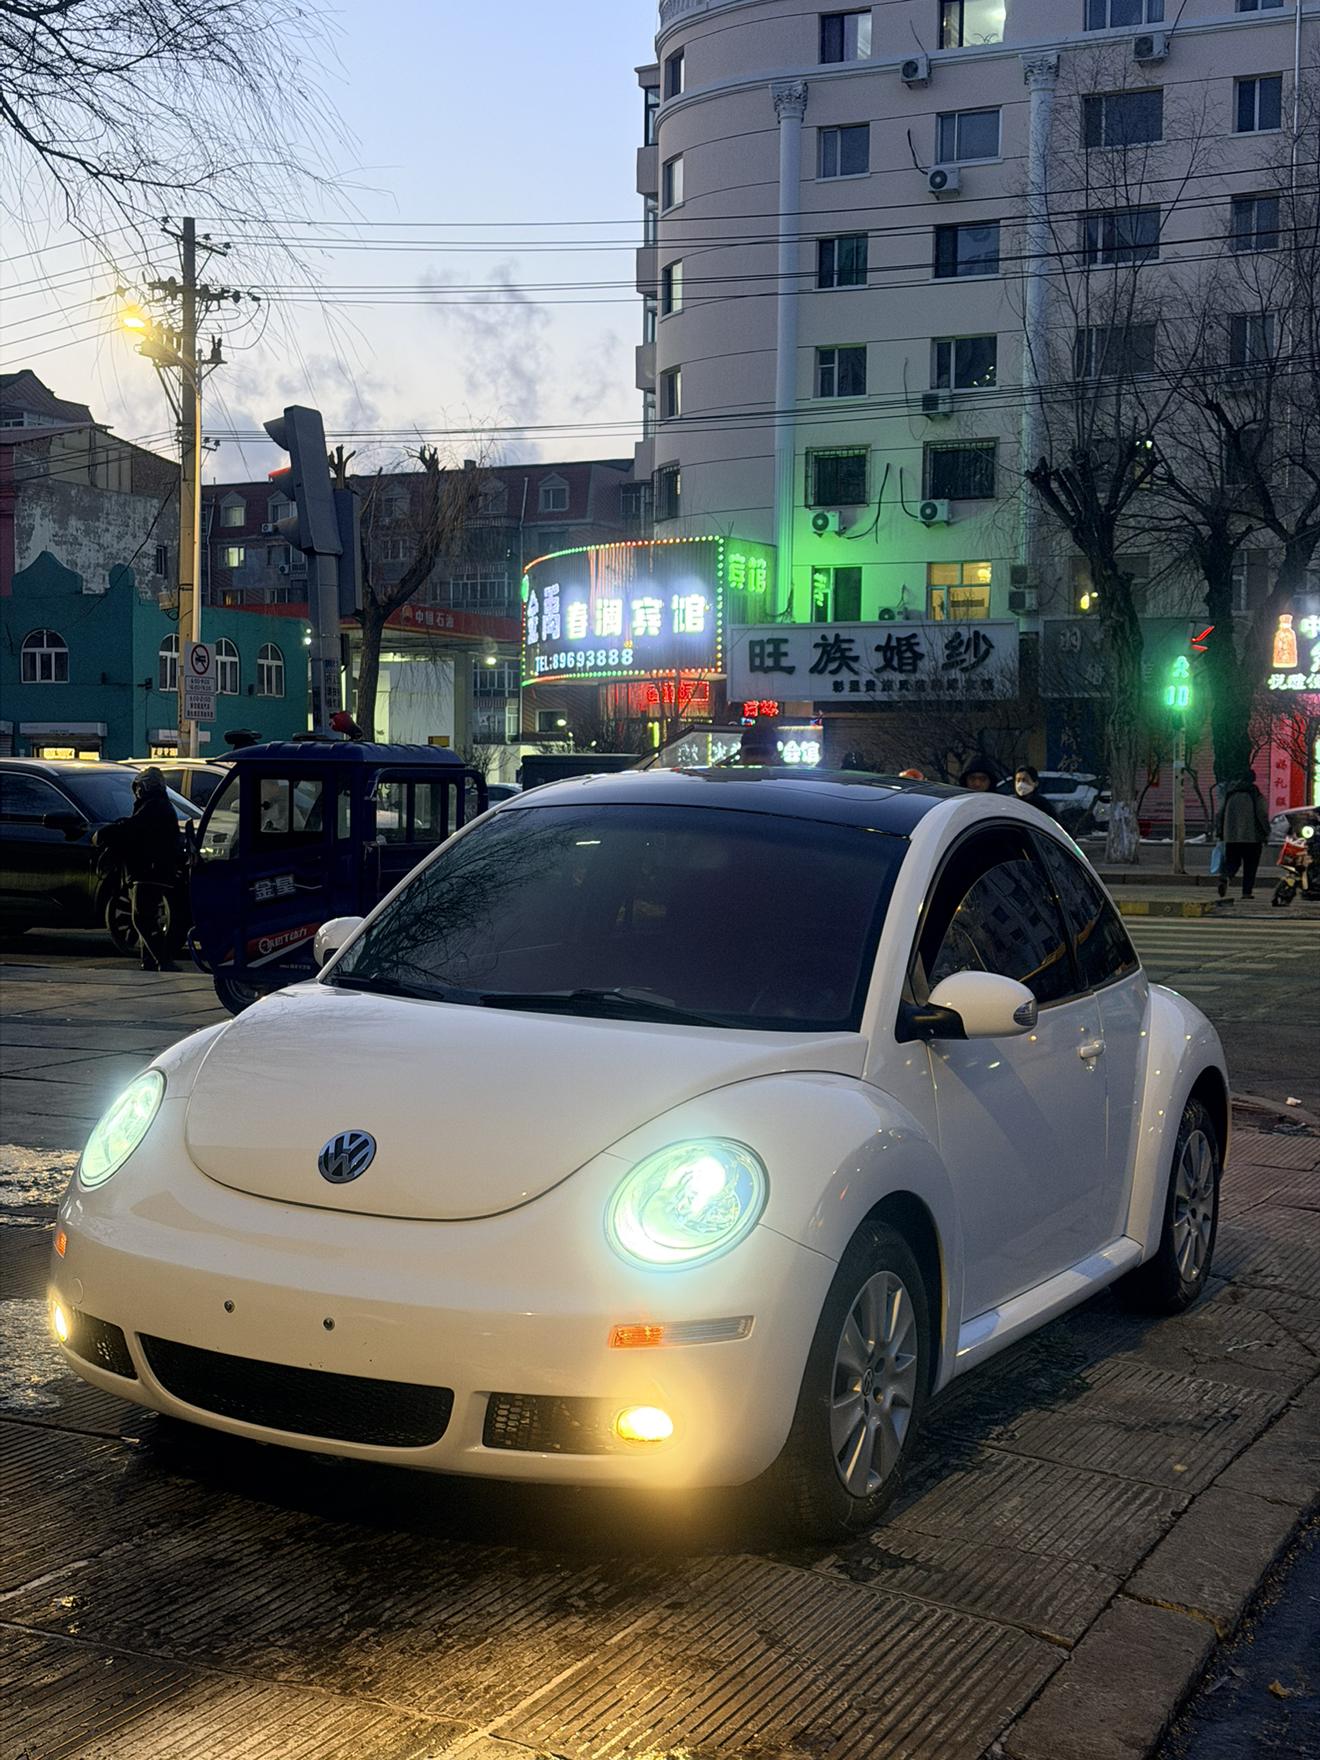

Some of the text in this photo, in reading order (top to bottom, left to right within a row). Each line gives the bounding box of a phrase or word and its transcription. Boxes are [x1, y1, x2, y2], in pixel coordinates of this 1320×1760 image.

[728, 553, 767, 593] 宾馆
[749, 630, 995, 676] 旺族婚纱
